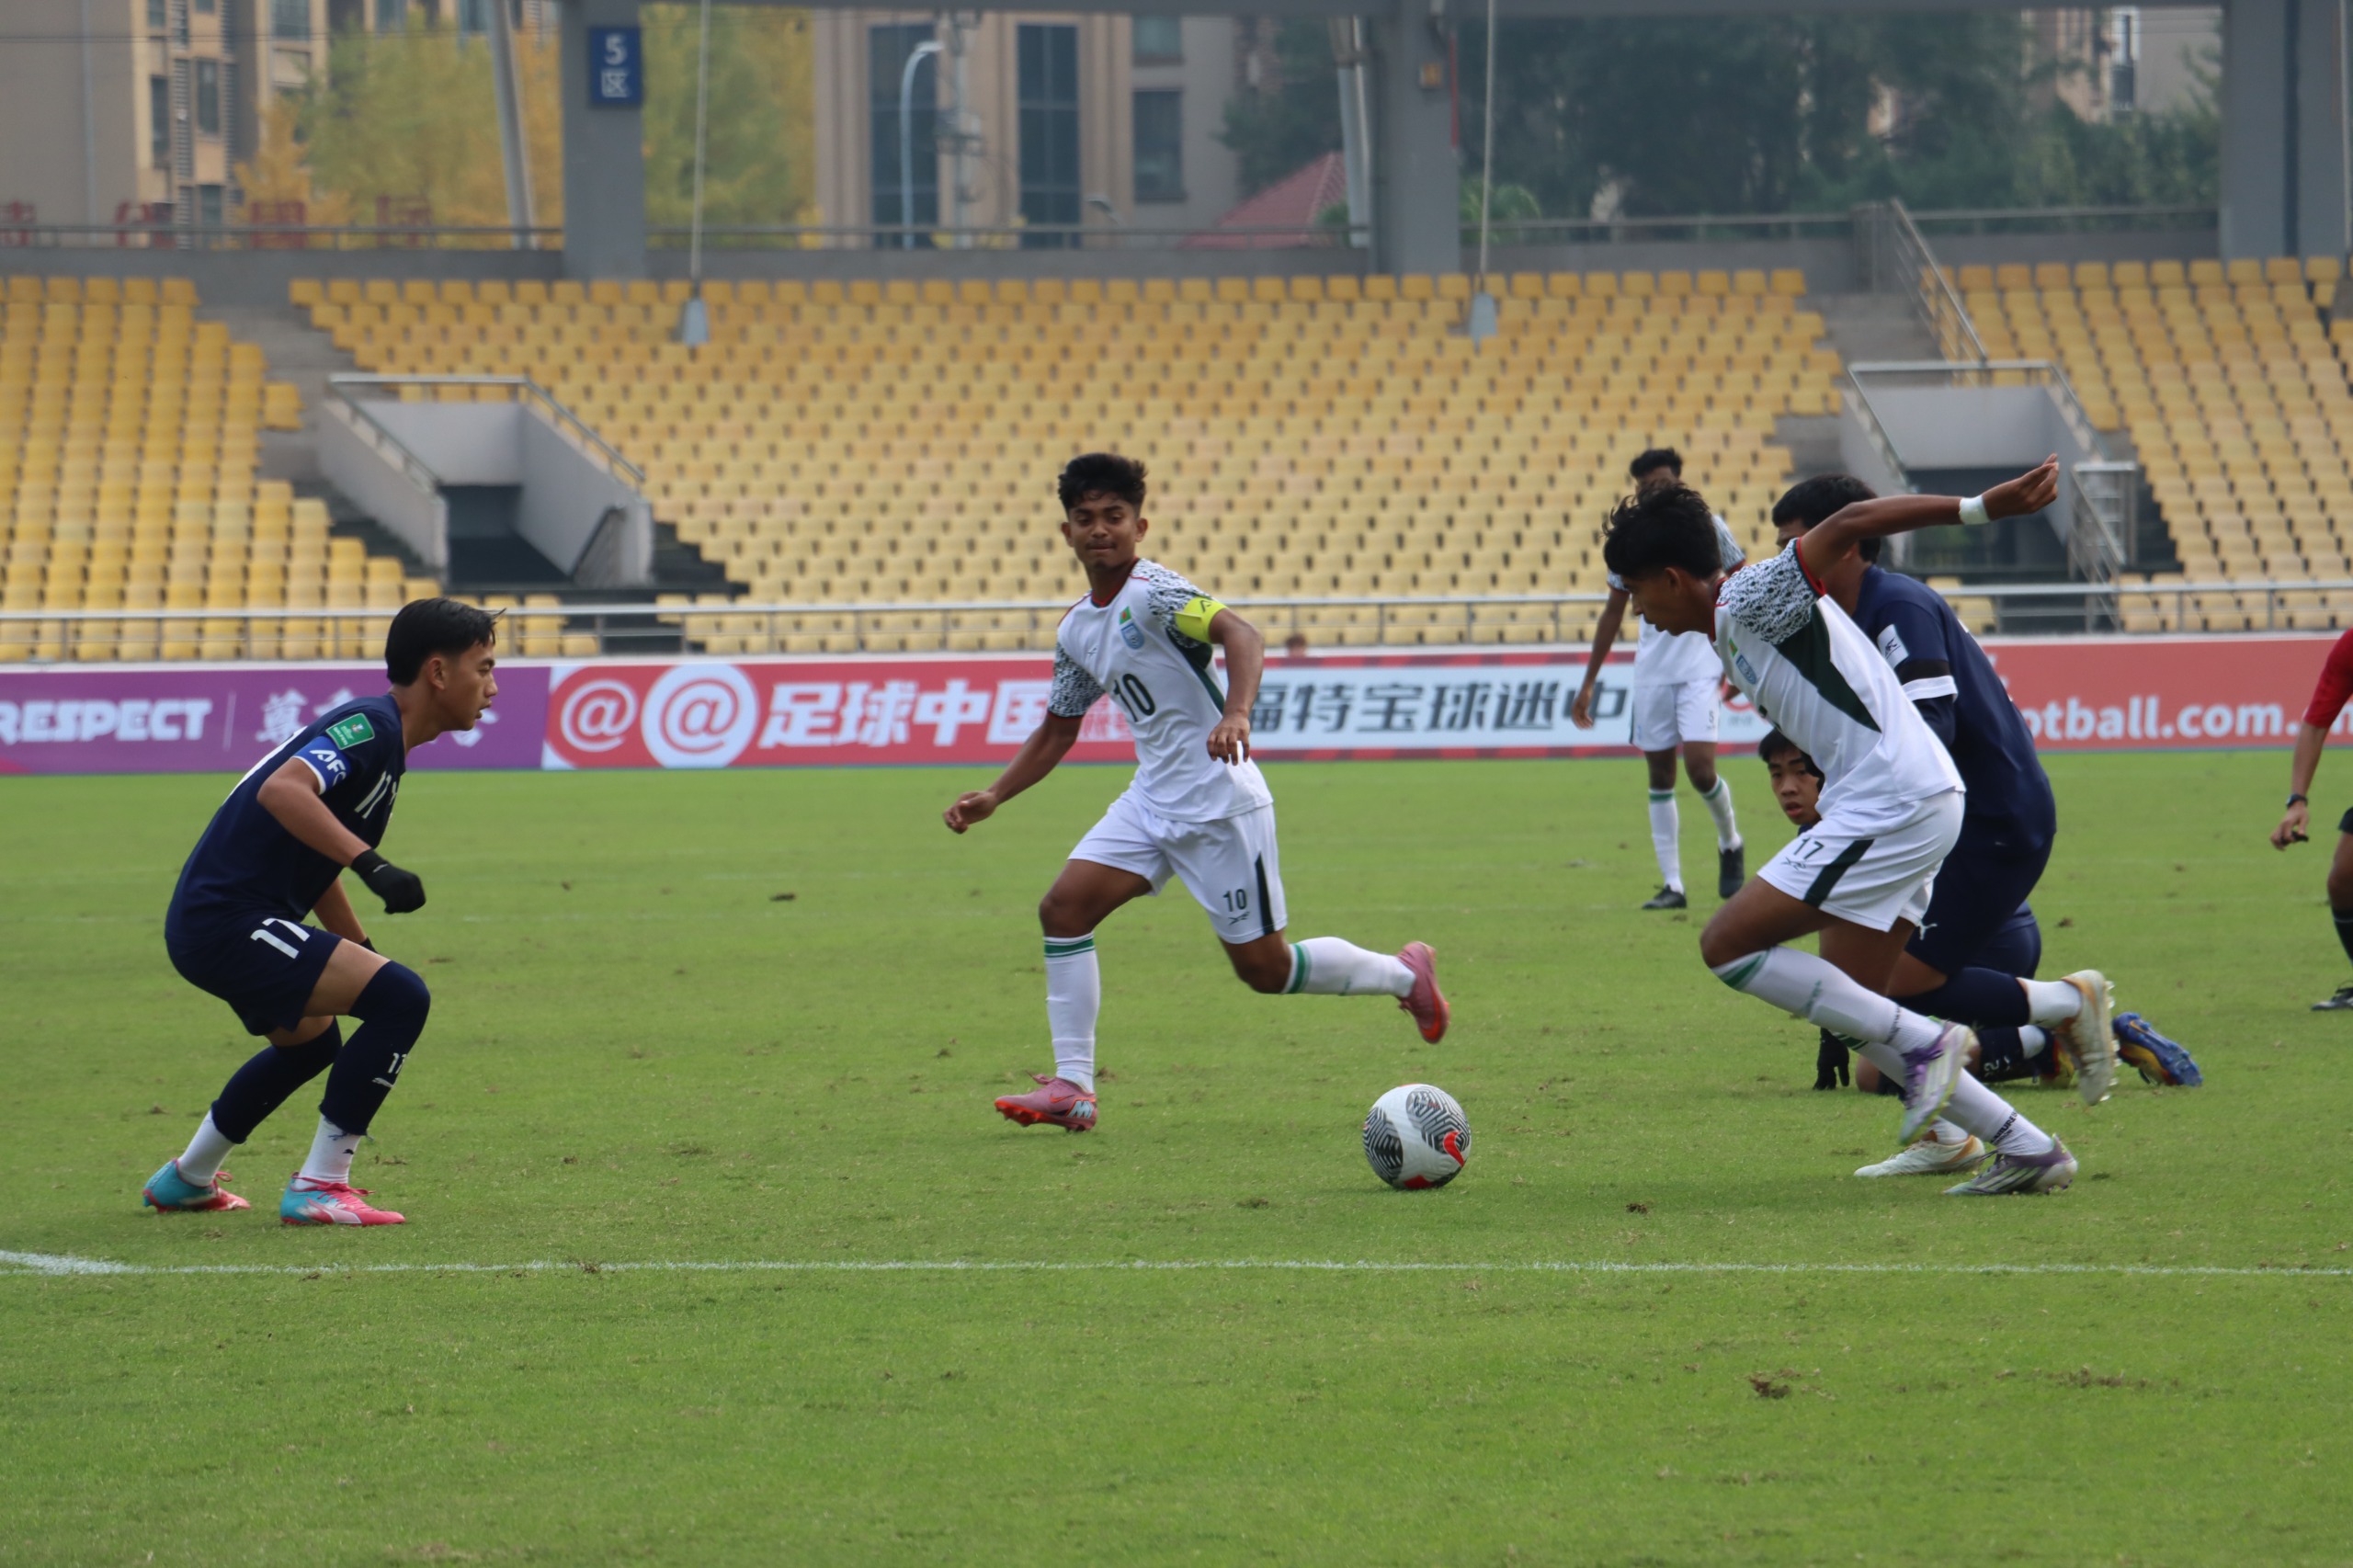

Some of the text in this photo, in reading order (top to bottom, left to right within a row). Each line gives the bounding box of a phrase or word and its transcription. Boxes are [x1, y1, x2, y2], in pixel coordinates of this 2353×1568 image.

[1113, 674, 1155, 722] 10
[1793, 836, 1824, 859] 17
[1222, 889, 1247, 912] 10
